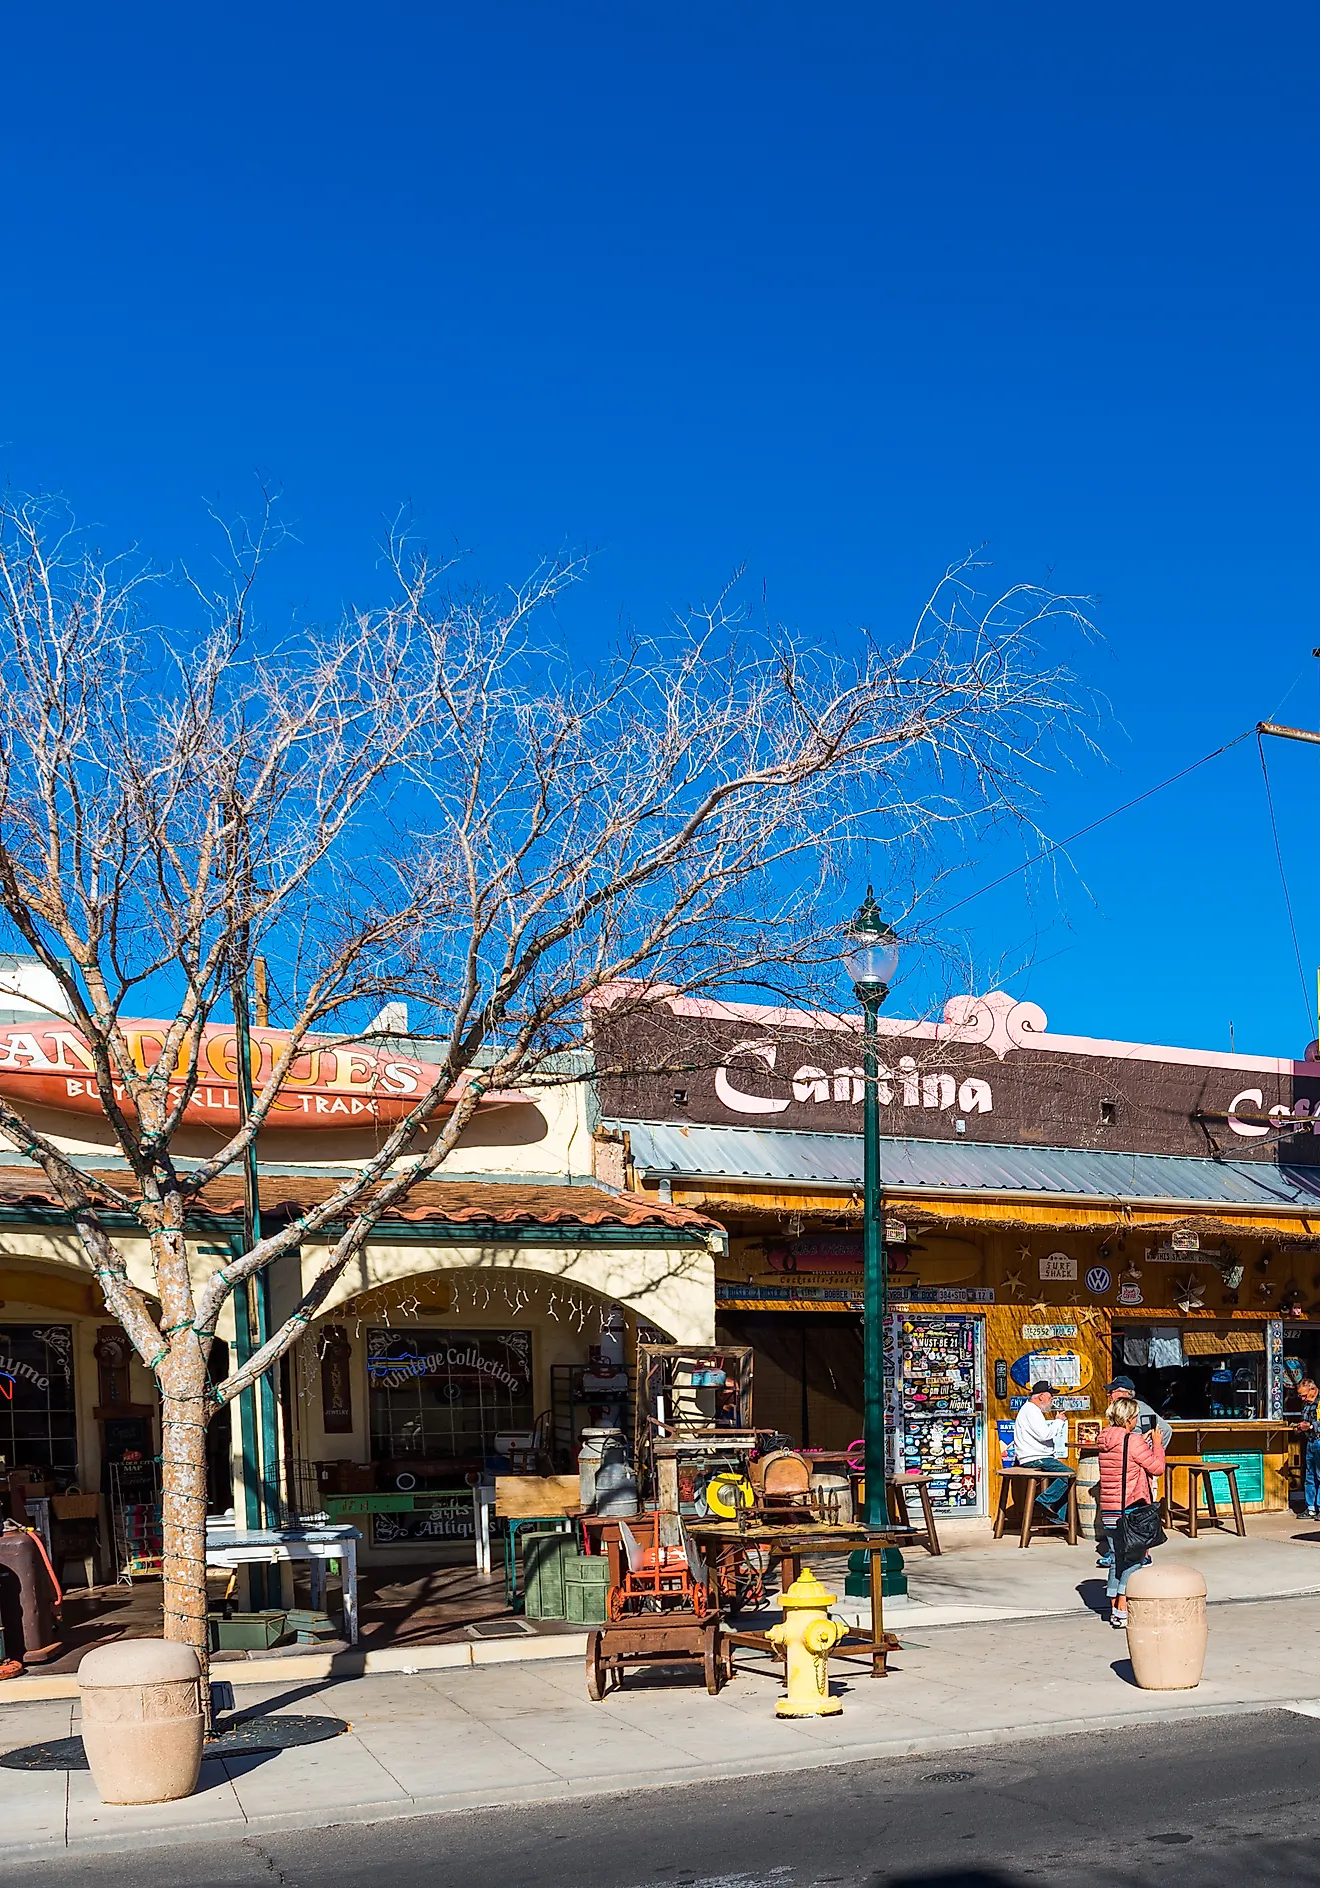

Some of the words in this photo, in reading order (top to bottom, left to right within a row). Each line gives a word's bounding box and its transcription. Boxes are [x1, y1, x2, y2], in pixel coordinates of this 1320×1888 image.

[0, 1028, 423, 1111] ANTIQUES
[714, 1037, 993, 1114] Cantina
[66, 1078, 125, 1101] BUY
[297, 1094, 379, 1116] TRADE
[1046, 1261, 1071, 1270] SURF
[1044, 1269, 1072, 1278] SHACK
[824, 1290, 848, 1299] BOBBER
[101, 1335, 126, 1346] SILVER
[1284, 1330, 1301, 1339] 512
[950, 1338, 958, 1347] 21
[0, 1353, 50, 1391] yme
[383, 1353, 445, 1389] Vintage
[447, 1348, 519, 1392] Collection
[949, 1400, 971, 1411] Nights
[429, 1498, 470, 1521] Gifts
[414, 1521, 496, 1538] Antiqus
